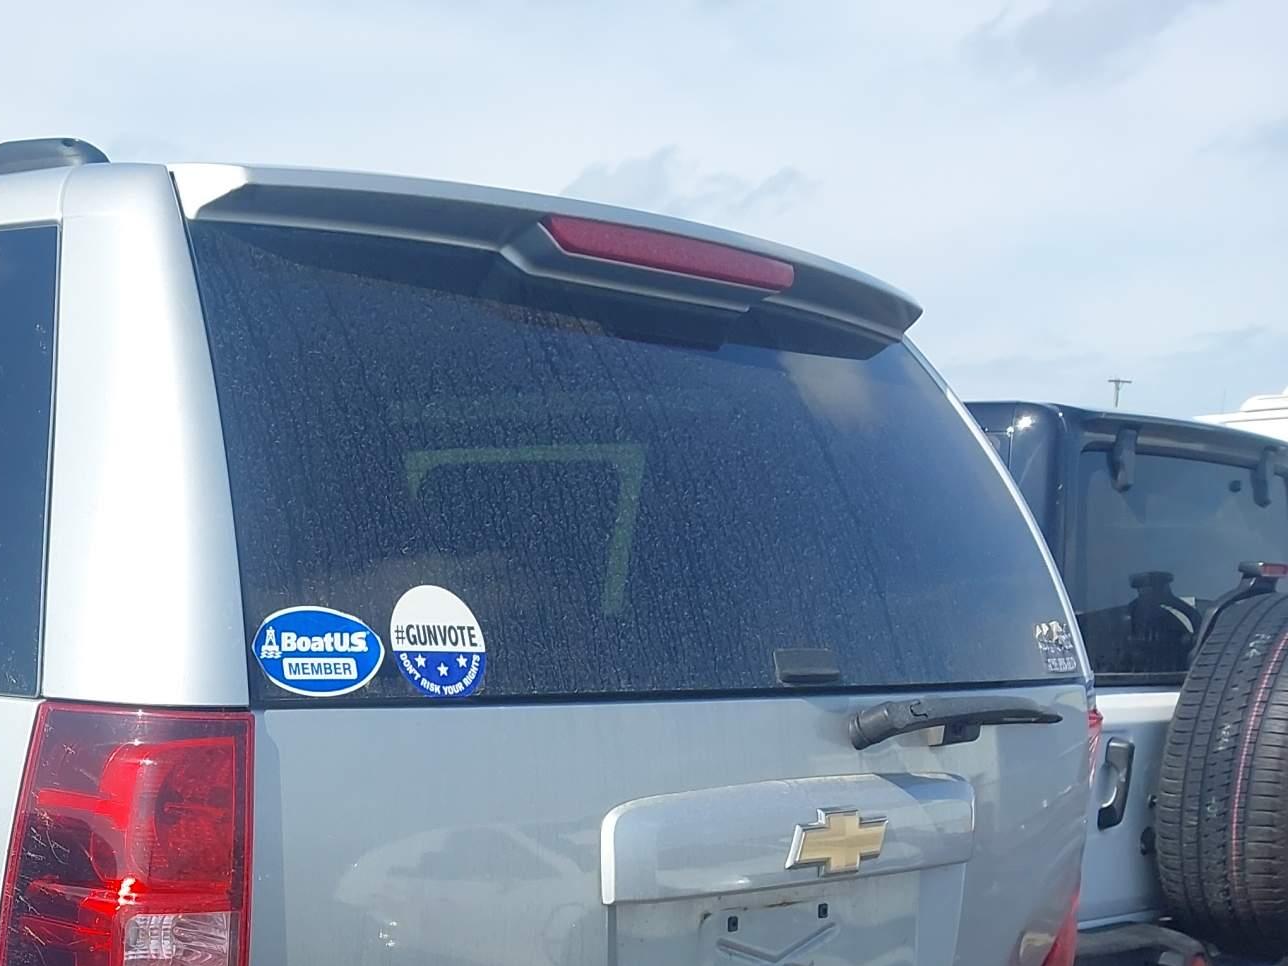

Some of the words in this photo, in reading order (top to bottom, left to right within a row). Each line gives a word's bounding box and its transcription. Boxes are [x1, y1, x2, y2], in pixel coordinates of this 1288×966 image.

[394, 623, 478, 647] #GUNVOTE
[288, 662, 352, 675] MEMBER
[400, 653, 421, 680] DON'T
[420, 678, 441, 695] RISK
[442, 682, 464, 695] YOUR
[462, 654, 481, 687] RIGHTS
